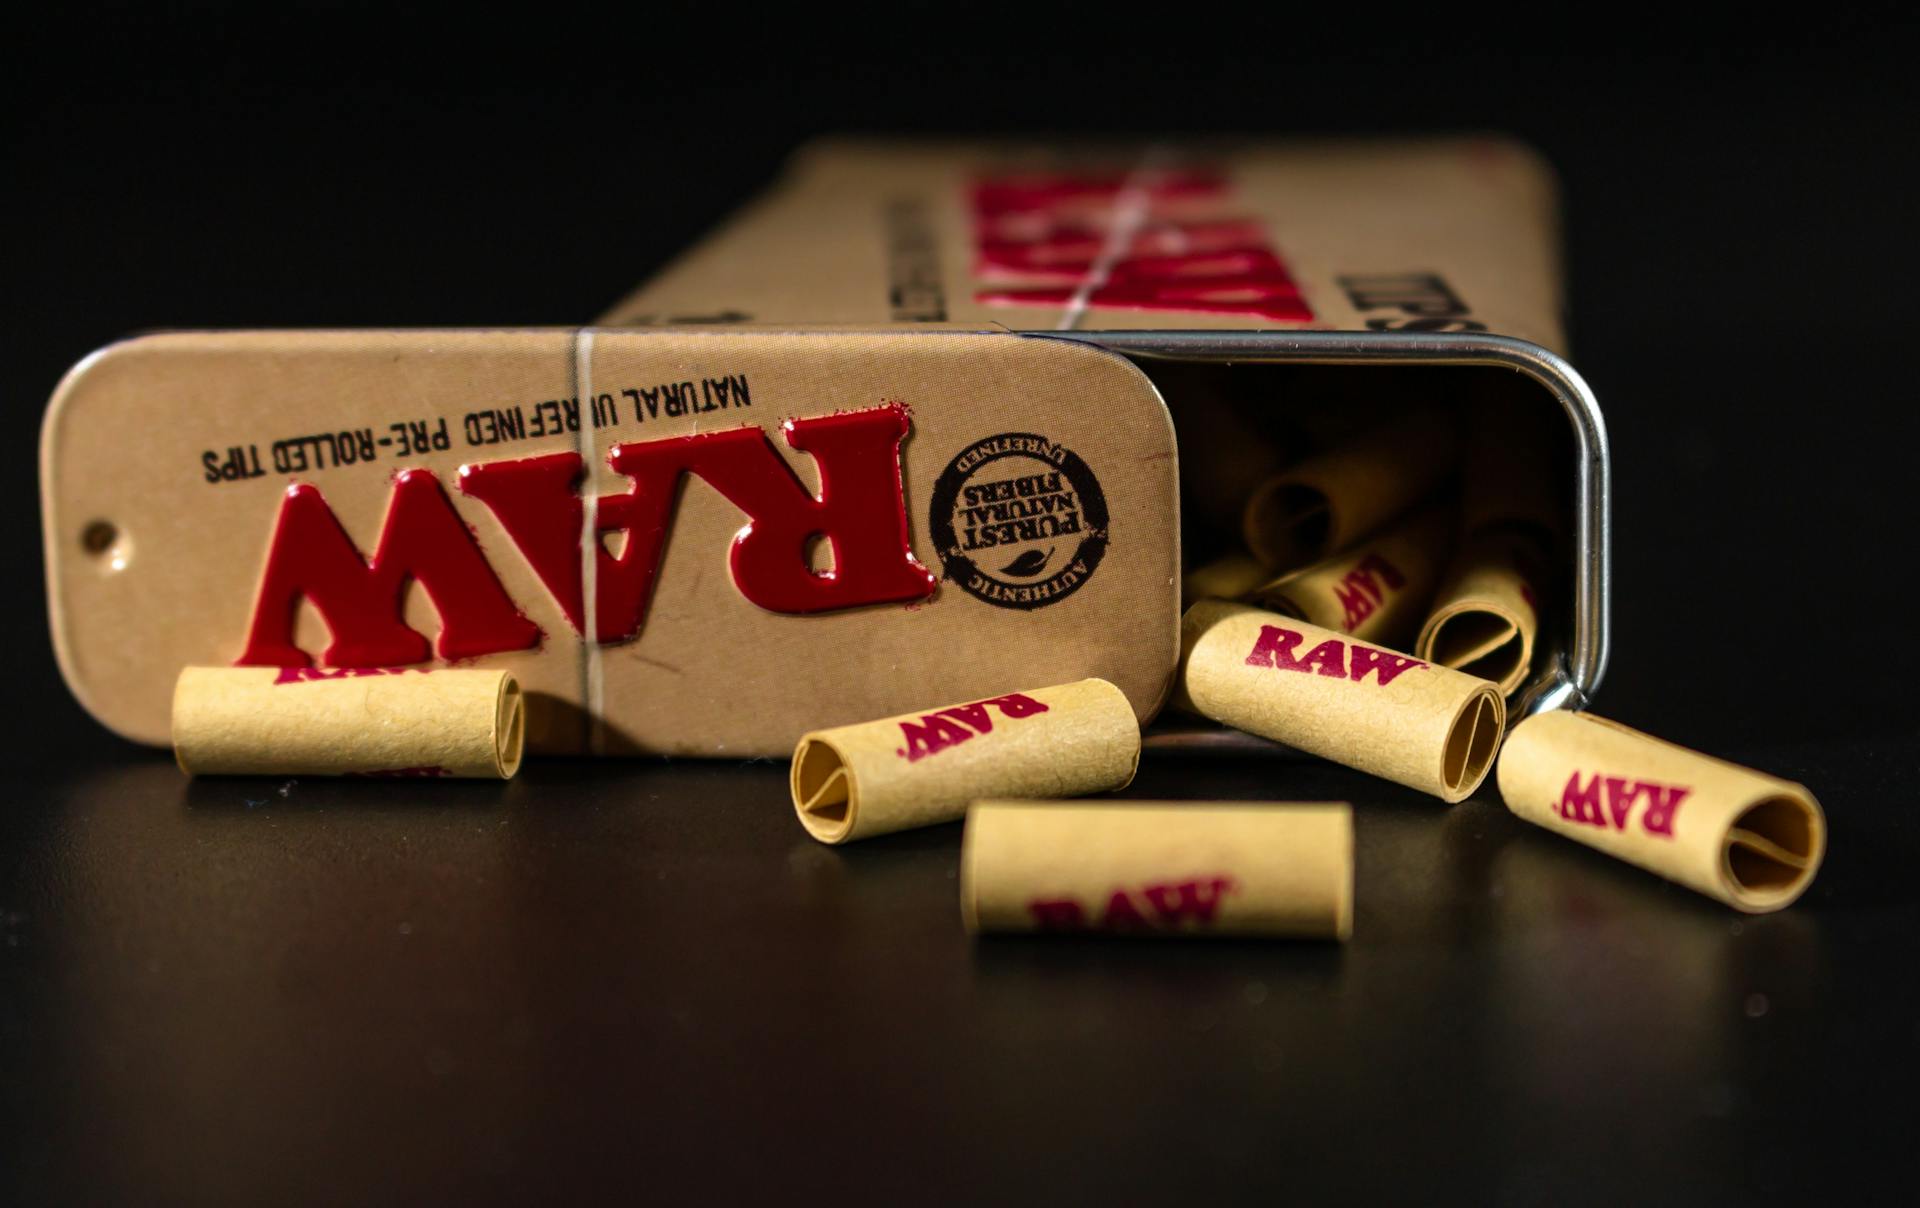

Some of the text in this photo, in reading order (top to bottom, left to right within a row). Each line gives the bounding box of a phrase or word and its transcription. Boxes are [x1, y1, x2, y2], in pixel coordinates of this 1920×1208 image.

[623, 374, 751, 423] NATURAL
[202, 445, 265, 484] TIPS
[274, 418, 450, 474] PRE-ROLLED
[956, 437, 1067, 472] UNREFINED
[958, 491, 1075, 527] NATURAL
[963, 472, 1063, 507] FIBERS
[235, 402, 938, 668] RAW
[962, 511, 1081, 550] PUREST
[967, 560, 1088, 602] AUTHENTIC
[1245, 625, 1427, 686] RAW
[897, 693, 1049, 763] RAW
[1559, 770, 1691, 838] RAW
